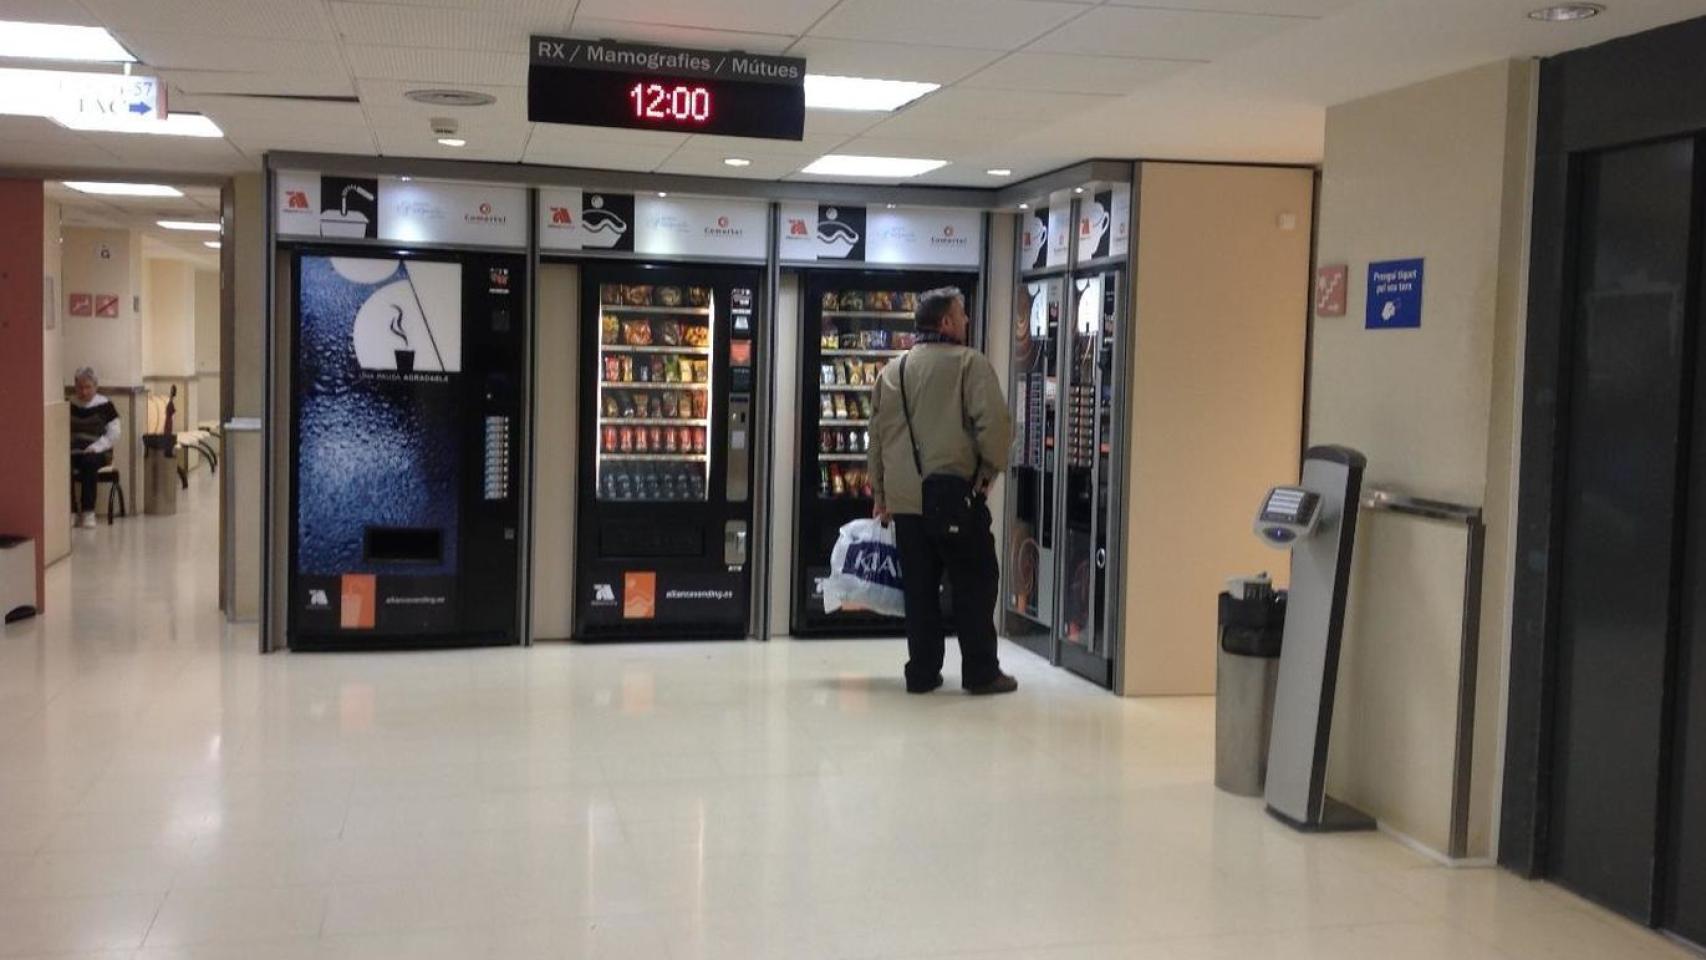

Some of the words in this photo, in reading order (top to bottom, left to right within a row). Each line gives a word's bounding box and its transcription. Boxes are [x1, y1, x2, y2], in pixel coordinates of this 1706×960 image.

[538, 41, 564, 58] RX
[569, 45, 581, 63] /
[587, 46, 711, 70] Mamografies
[714, 57, 727, 74] /
[732, 57, 799, 78] Mútues
[630, 82, 710, 121] 12:00
